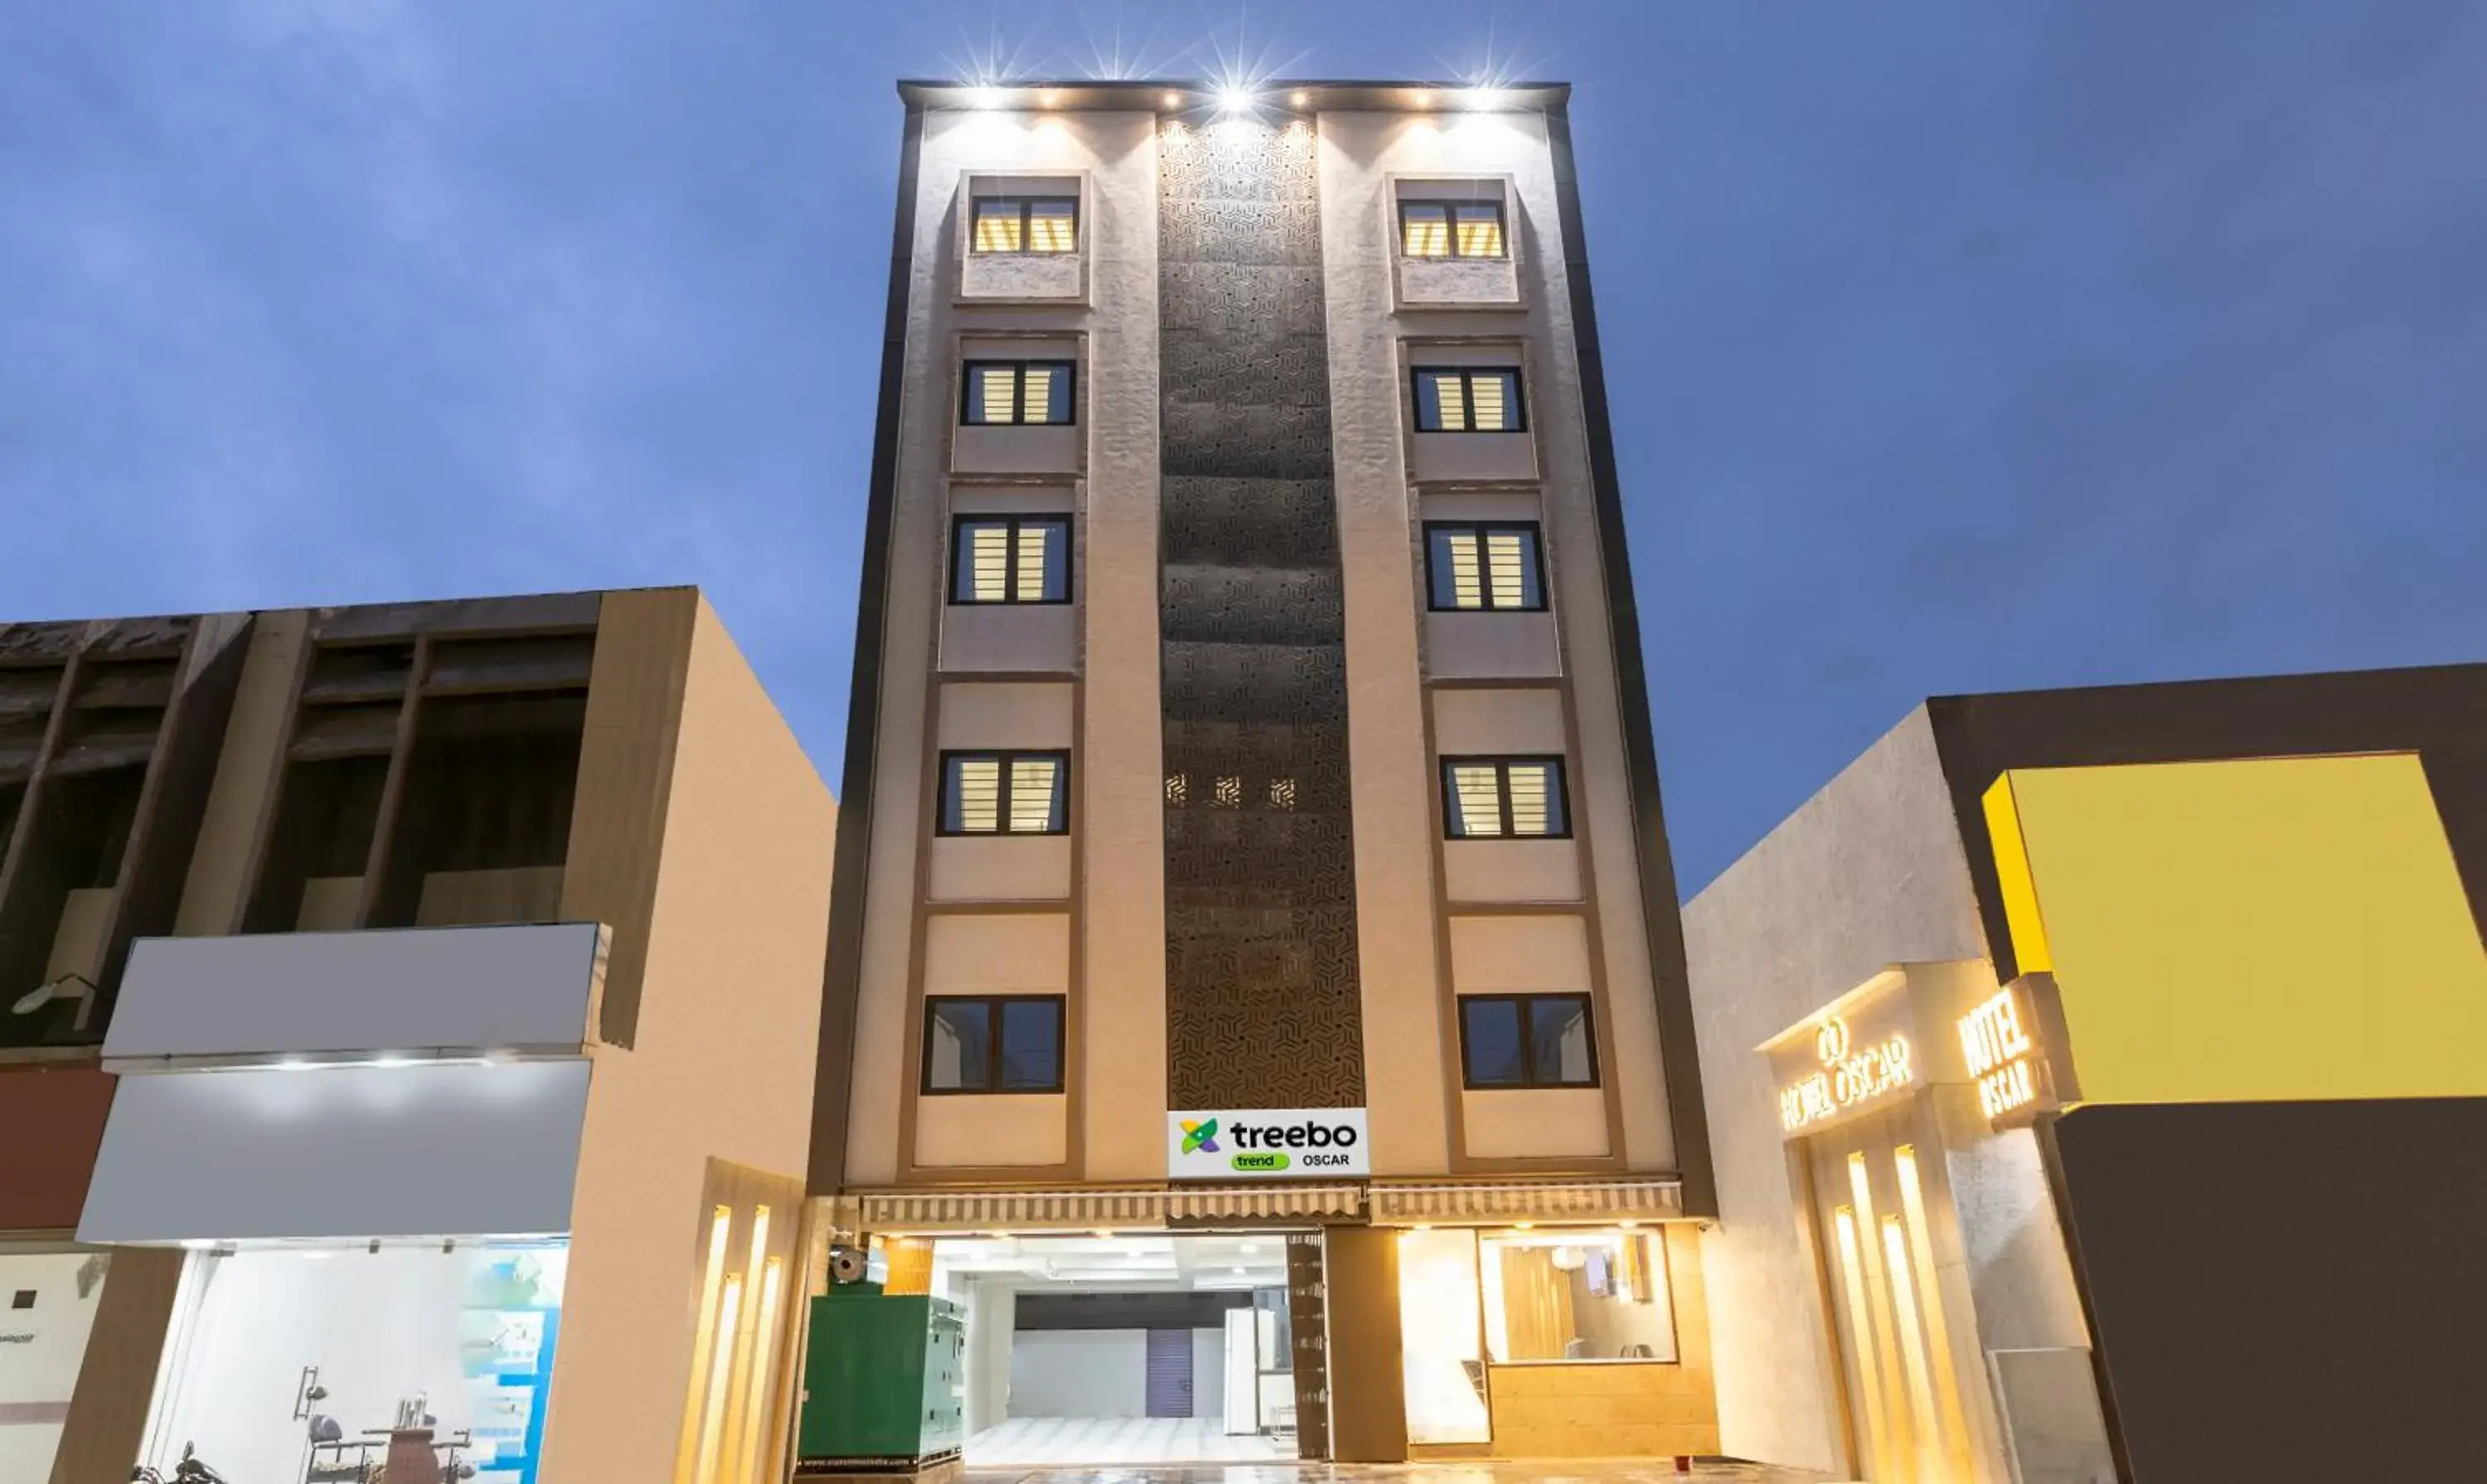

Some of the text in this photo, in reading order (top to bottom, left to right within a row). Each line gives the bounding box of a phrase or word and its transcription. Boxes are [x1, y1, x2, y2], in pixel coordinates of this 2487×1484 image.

[1957, 987, 2030, 1079] HOTEL
[1780, 1035, 1913, 1132] HOTEL OSCAR
[1979, 1060, 2034, 1119] OSCAR
[1230, 1121, 1357, 1148] treebo
[1237, 1156, 1274, 1167] trend
[1302, 1154, 1350, 1166] OSCAR
